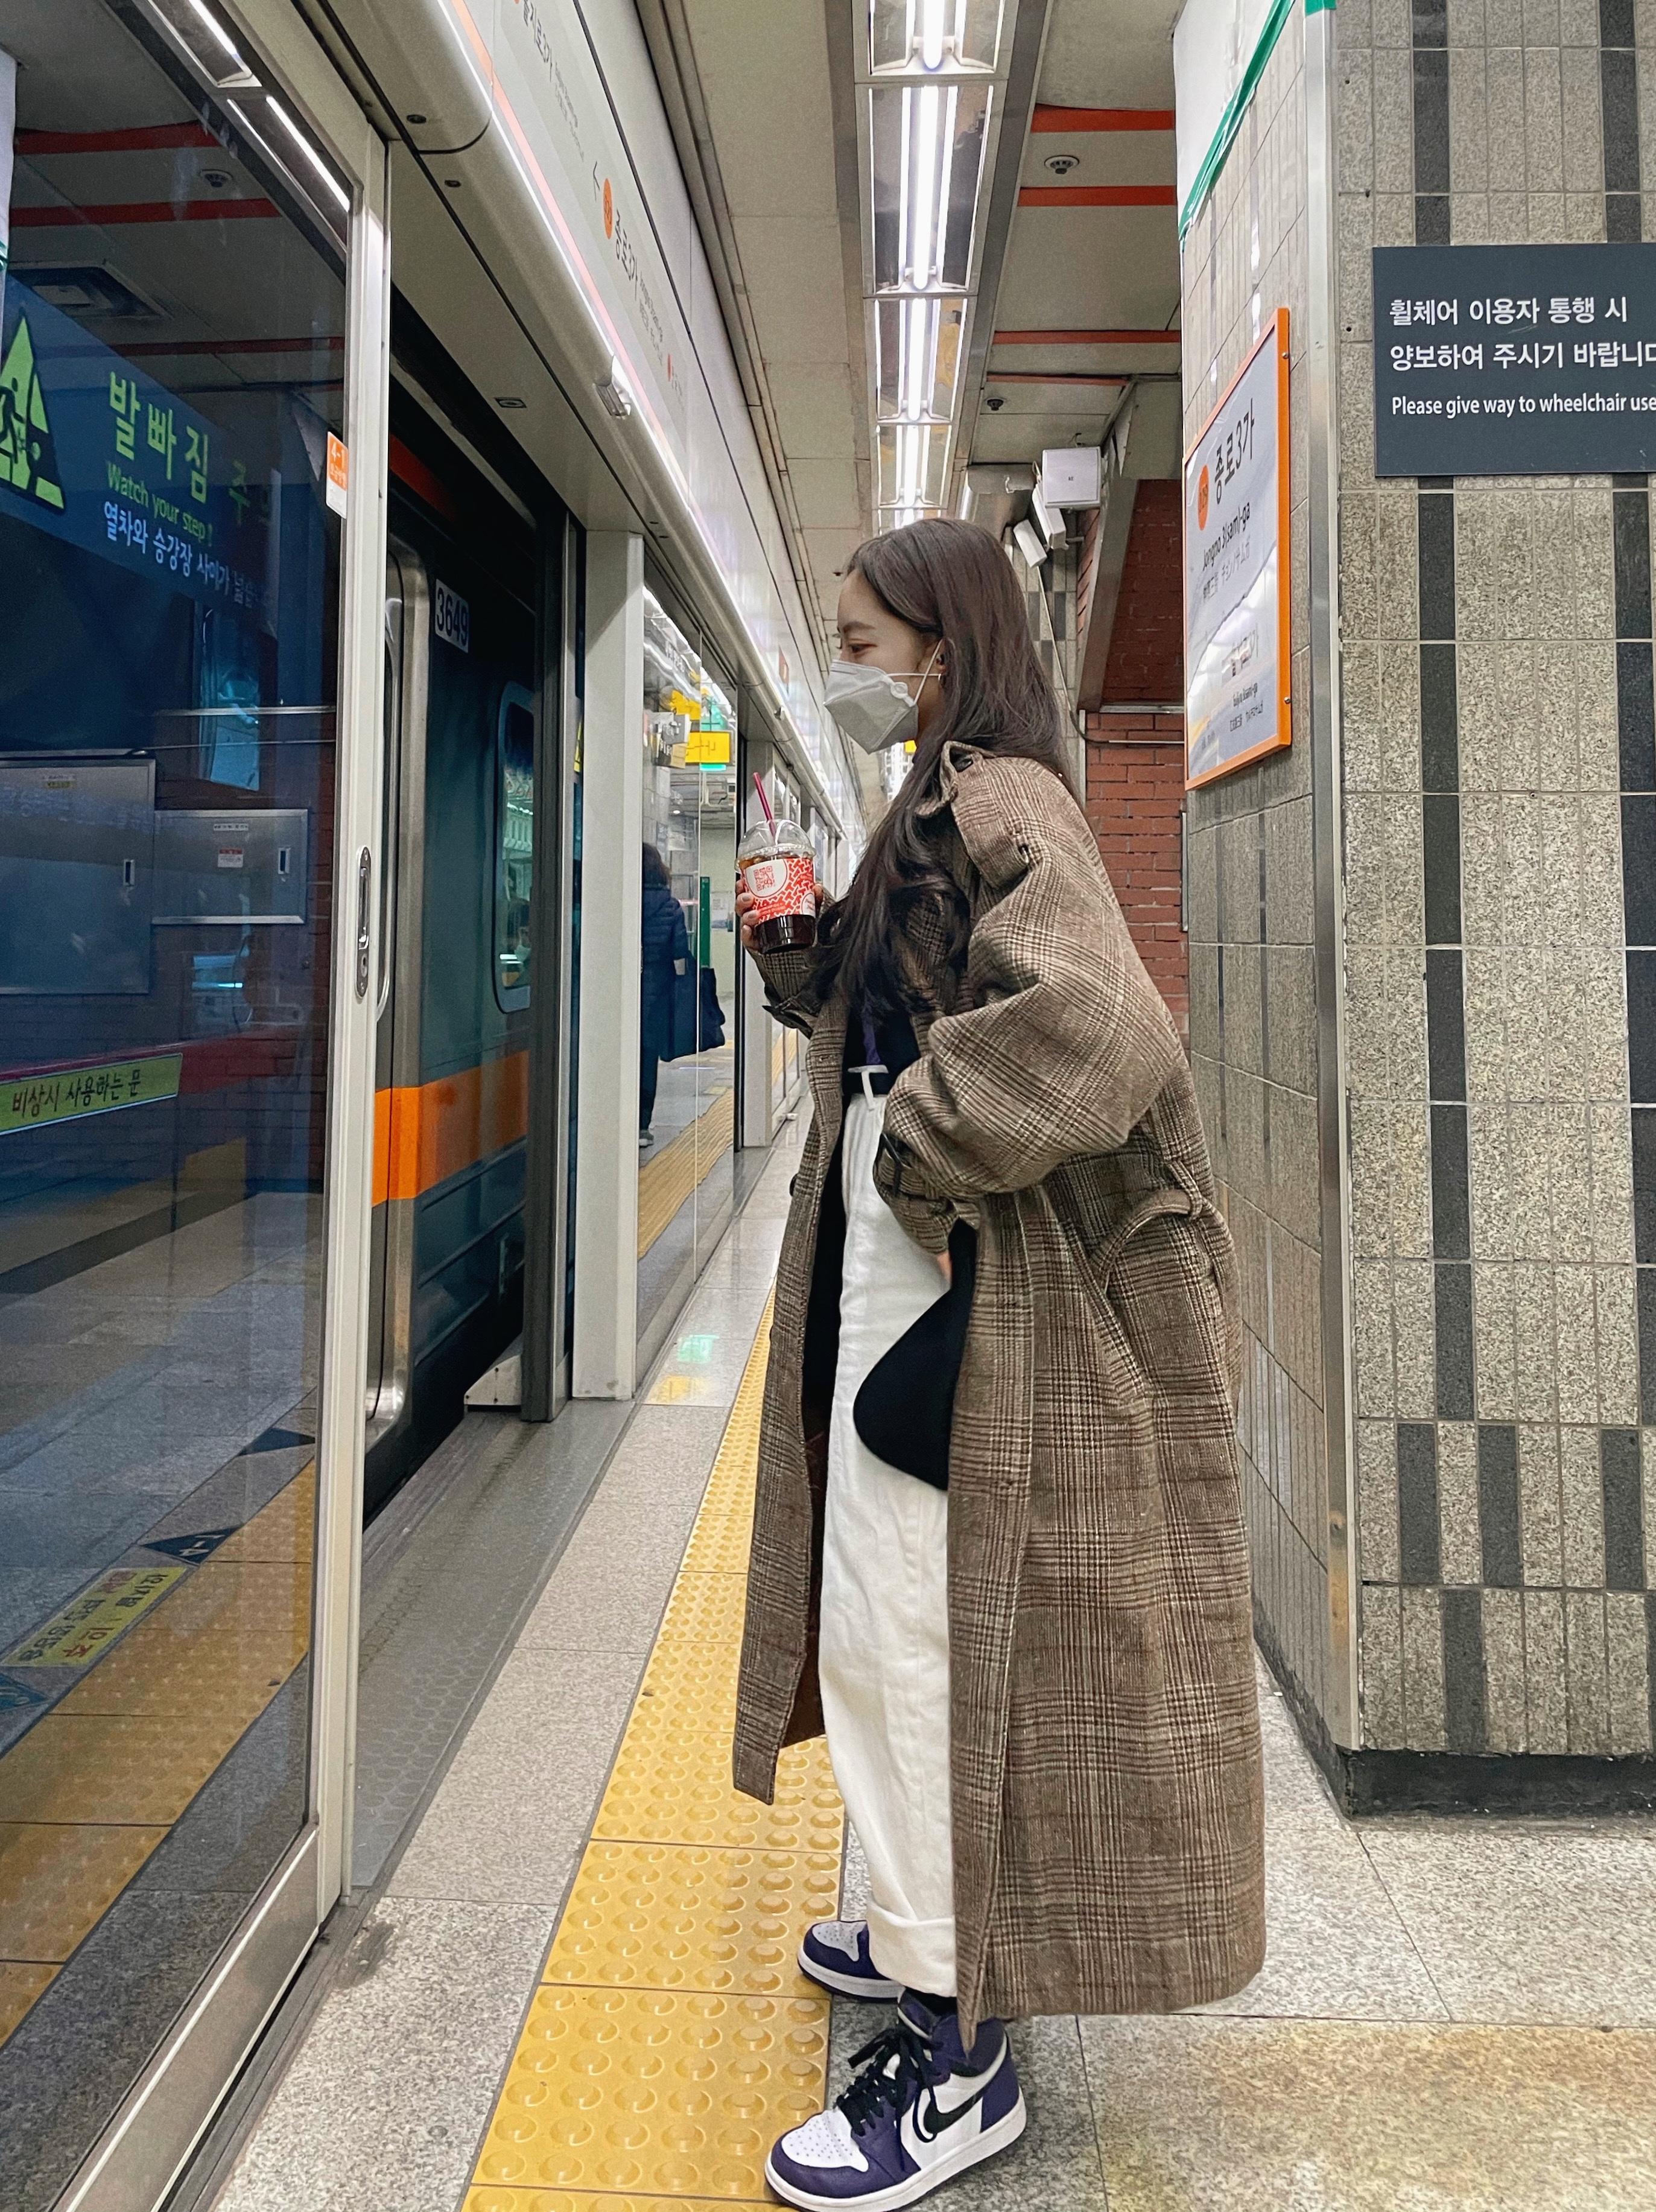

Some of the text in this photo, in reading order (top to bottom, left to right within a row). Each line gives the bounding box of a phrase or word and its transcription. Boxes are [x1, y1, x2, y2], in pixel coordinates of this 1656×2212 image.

[615, 208, 638, 301] 종로3가
[1389, 296, 1628, 326] 휠체어 이용자 통행 시
[1390, 343, 1484, 372] 양보하여
[1493, 342, 1564, 369] 주시기
[1392, 395, 1442, 415] Please
[1445, 395, 1480, 419] give
[1483, 395, 1516, 418] way
[1518, 395, 1536, 413] to
[1539, 392, 1627, 413] wheelchair
[109, 370, 210, 504] 발빠짐
[1214, 397, 1255, 505] 종로3가
[106, 460, 149, 508] Watch
[152, 494, 180, 525] your
[104, 501, 149, 555] 열차와
[153, 527, 192, 577] 승강장
[436, 587, 468, 647] 3649
[12, 1069, 141, 1117] 비상시 사용하는 문
